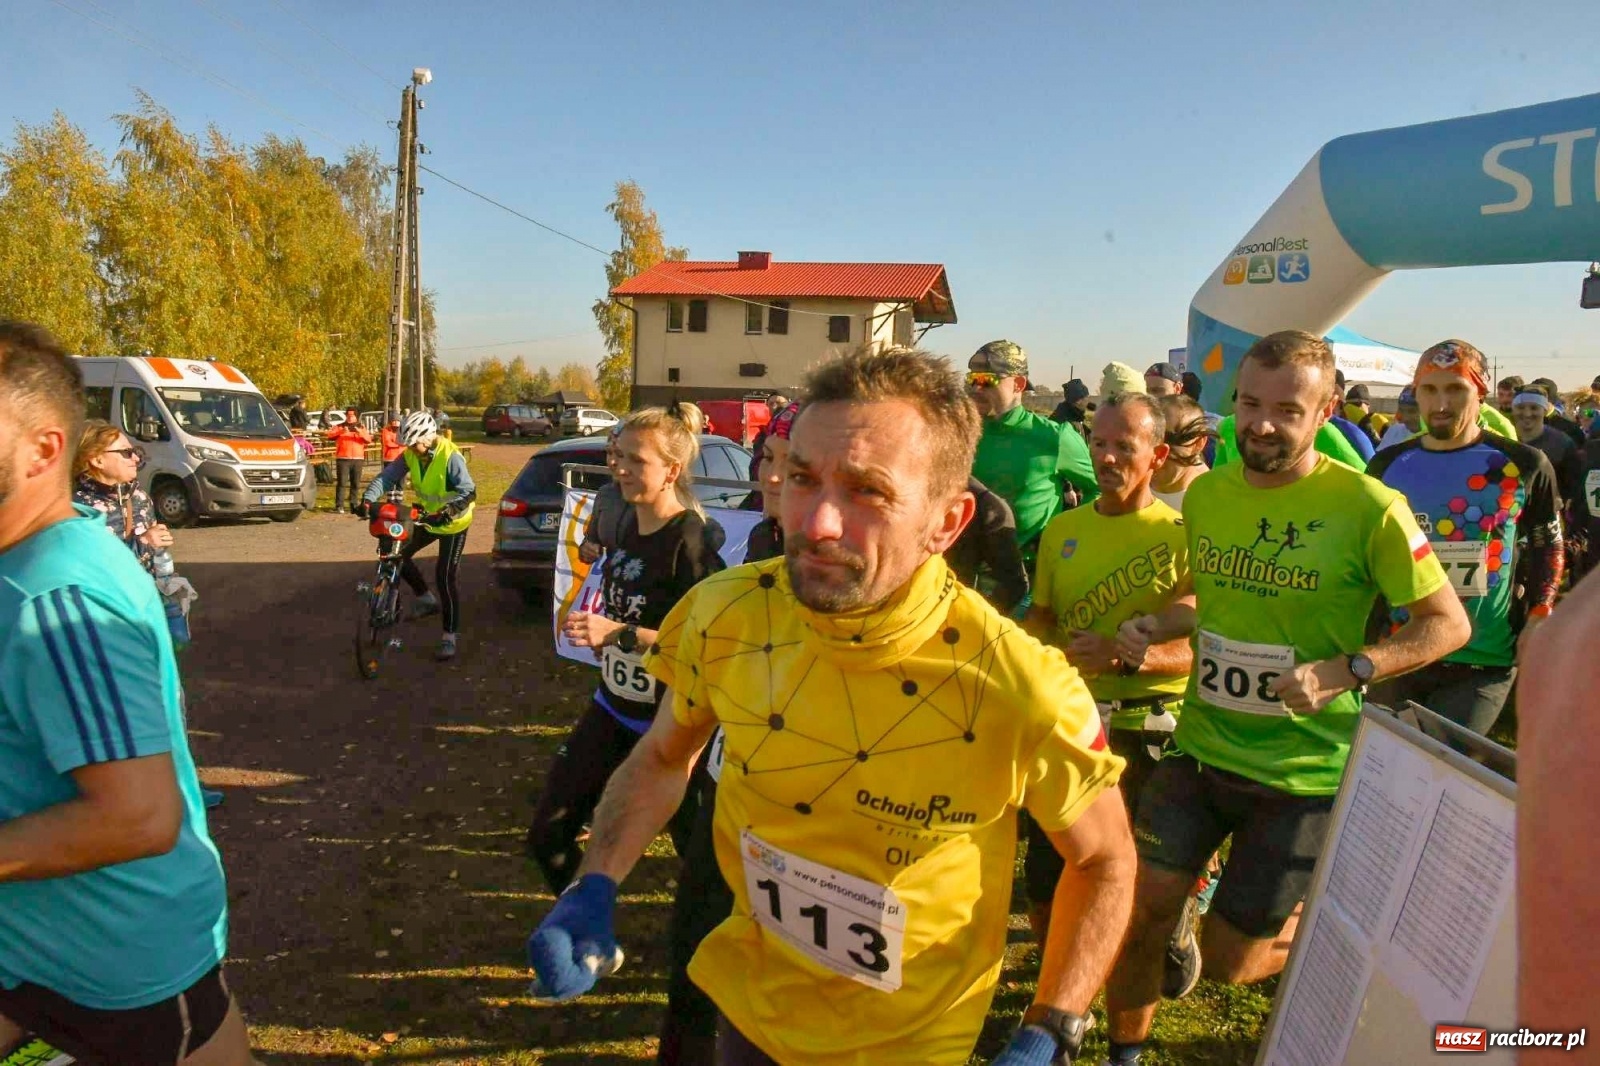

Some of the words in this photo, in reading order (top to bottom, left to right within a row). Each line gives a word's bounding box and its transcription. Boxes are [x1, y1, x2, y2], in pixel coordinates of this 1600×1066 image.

[1480, 127, 1600, 215] ST
[1194, 536, 1320, 591] Radlinioki
[1214, 579, 1228, 589] w
[1231, 578, 1279, 598] biegu
[604, 652, 650, 692] 165
[1201, 657, 1281, 703] 208
[793, 869, 900, 916] www.personalbest.pl
[756, 878, 890, 973] 113
